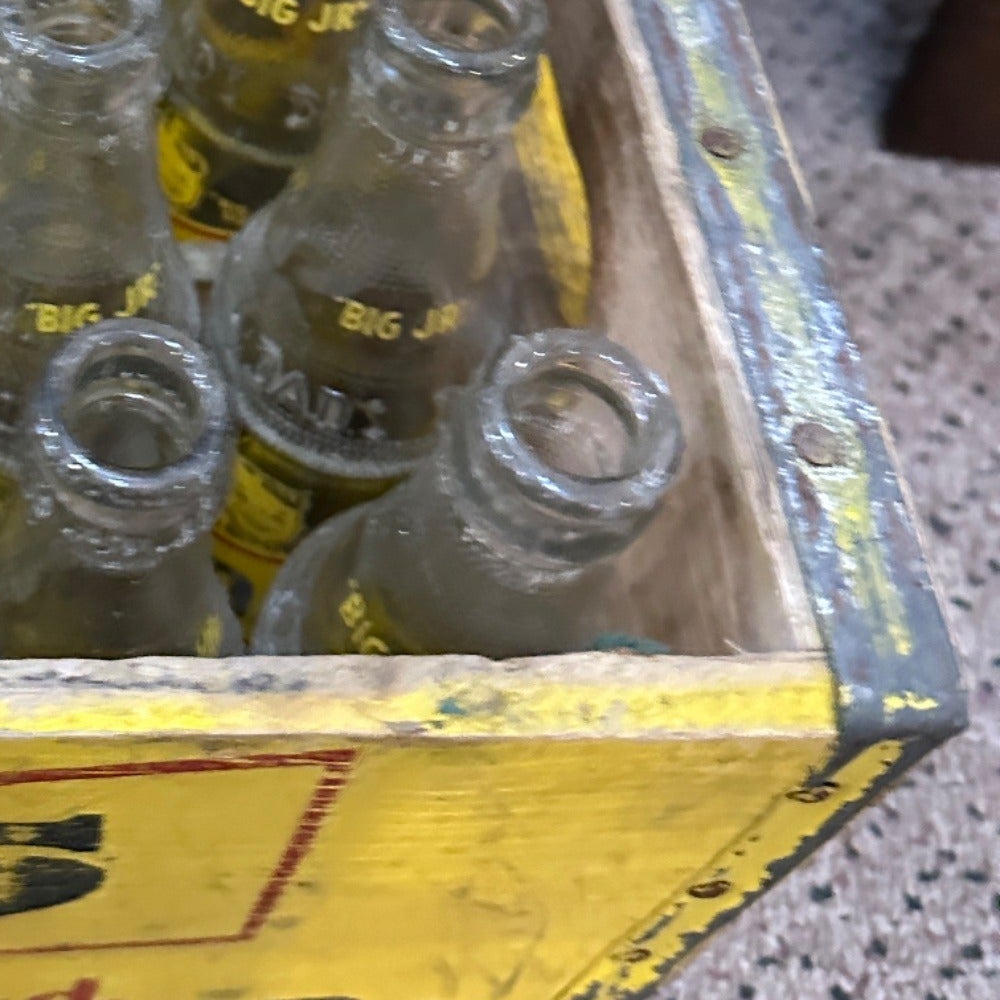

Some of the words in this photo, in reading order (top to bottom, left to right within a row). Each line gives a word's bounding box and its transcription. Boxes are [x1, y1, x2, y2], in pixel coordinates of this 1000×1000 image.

[307, 1, 369, 33] JR
[24, 302, 102, 334] BIG
[335, 296, 404, 341] BIG
[411, 301, 468, 340] JR
